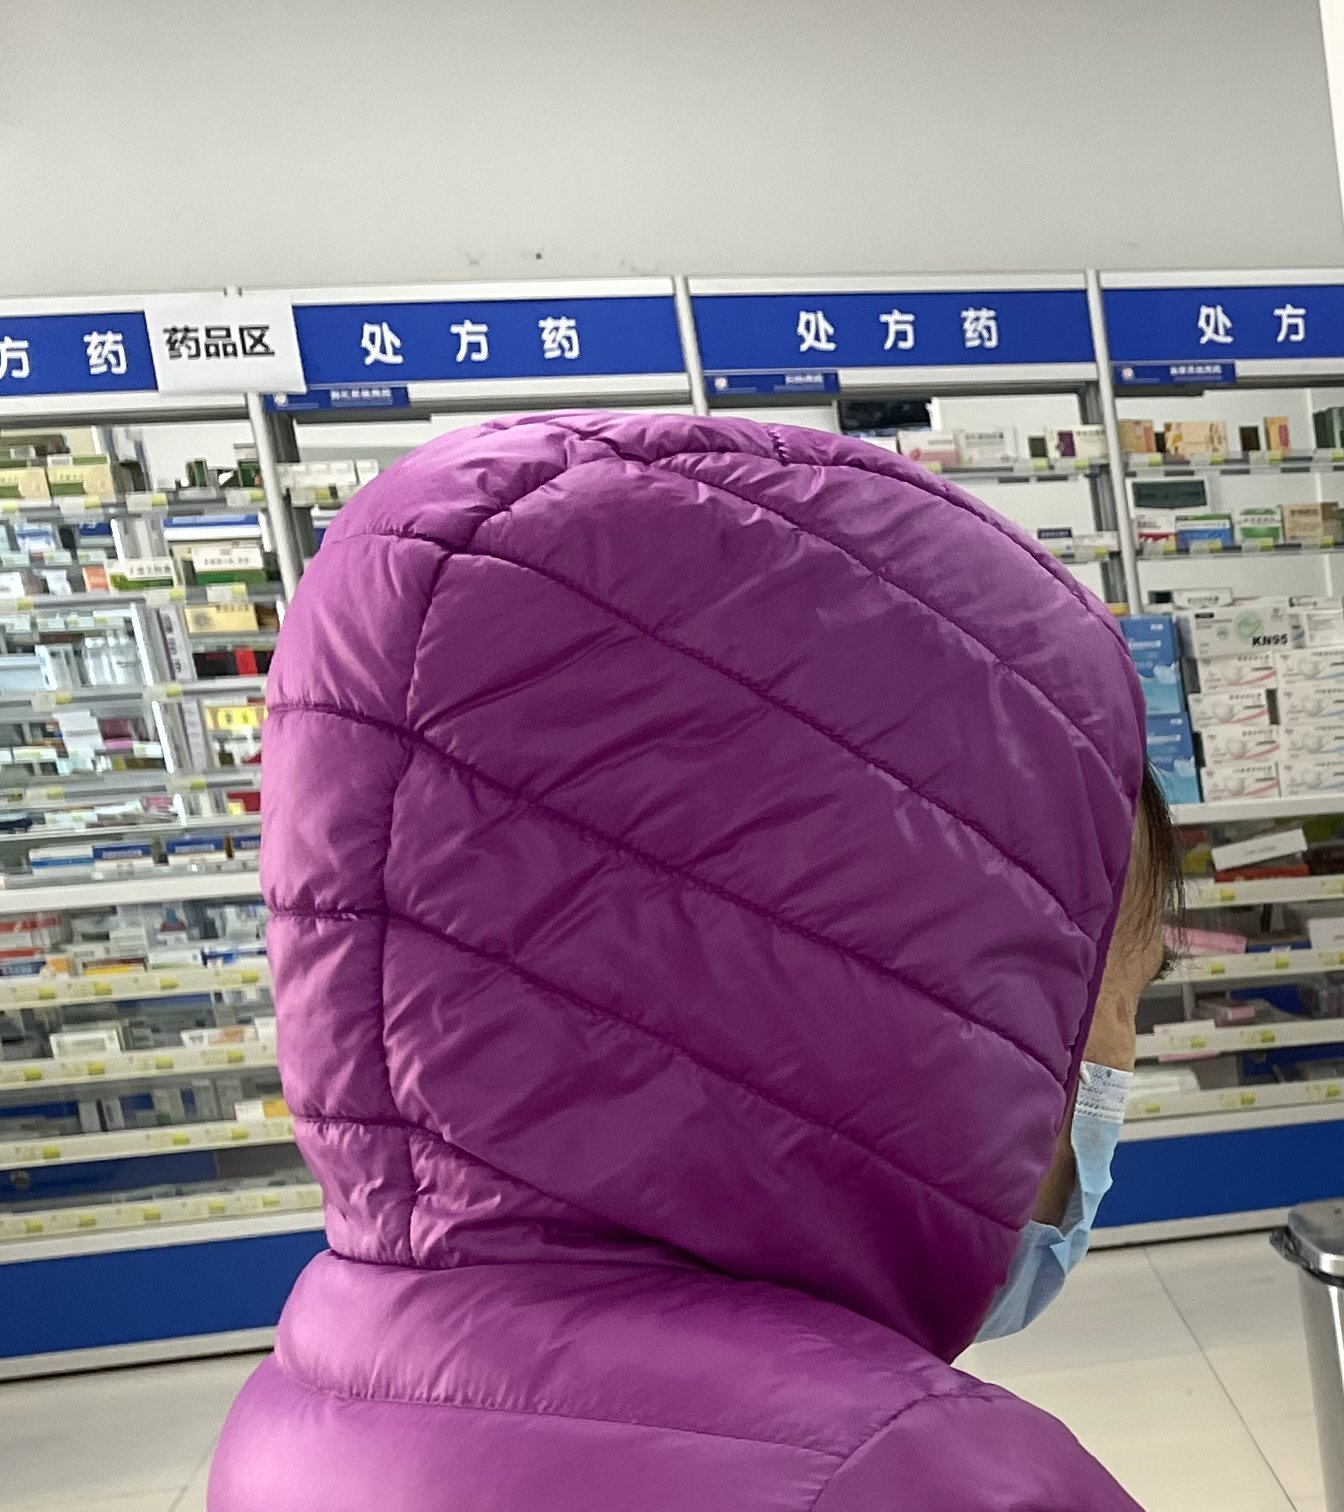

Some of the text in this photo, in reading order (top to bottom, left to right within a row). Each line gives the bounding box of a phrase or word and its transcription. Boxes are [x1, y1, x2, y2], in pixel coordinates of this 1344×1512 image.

[163, 324, 275, 362] 药品区
[360, 316, 581, 366] 处方药
[796, 306, 1000, 353] 处方药
[1252, 634, 1288, 647] KN95
